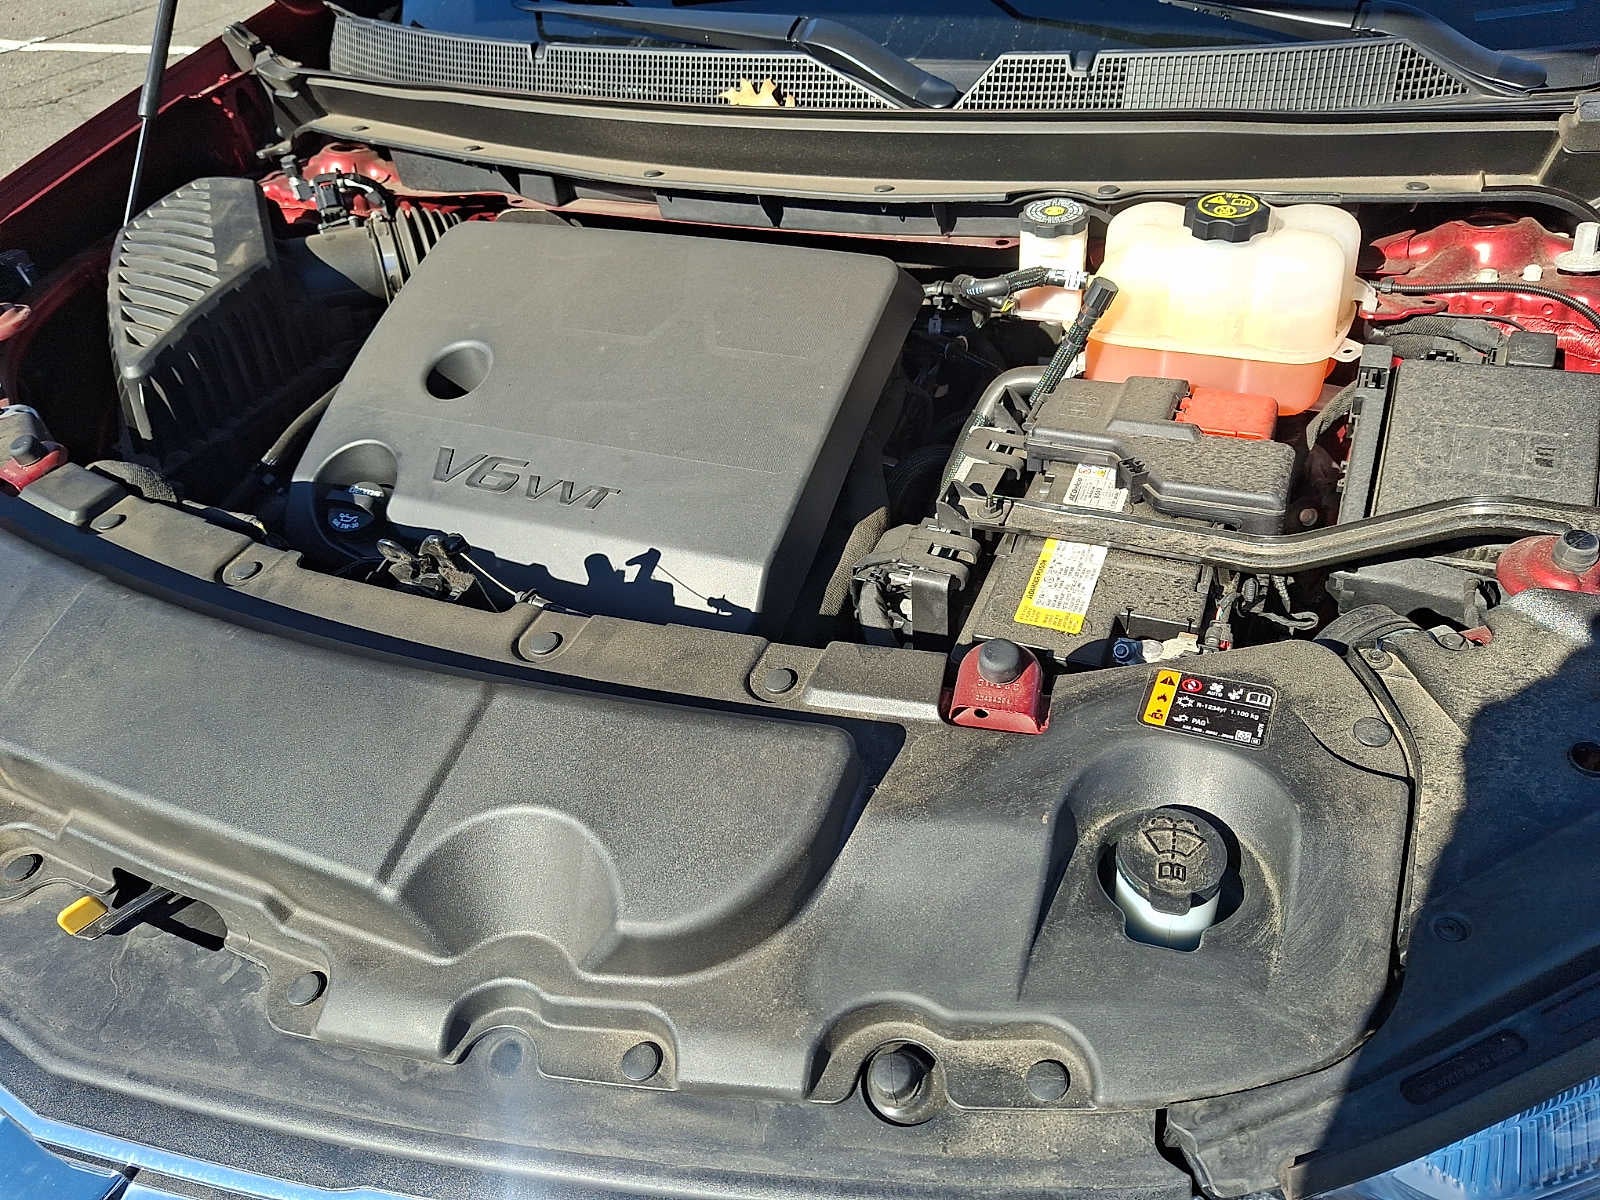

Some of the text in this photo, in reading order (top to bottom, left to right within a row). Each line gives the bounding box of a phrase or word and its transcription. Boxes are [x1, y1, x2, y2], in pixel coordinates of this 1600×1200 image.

[433, 446, 622, 510] V6 VVT
[1206, 690, 1223, 698] AUTO
[1196, 702, 1260, 721] R-1234yf 1.100 kg
